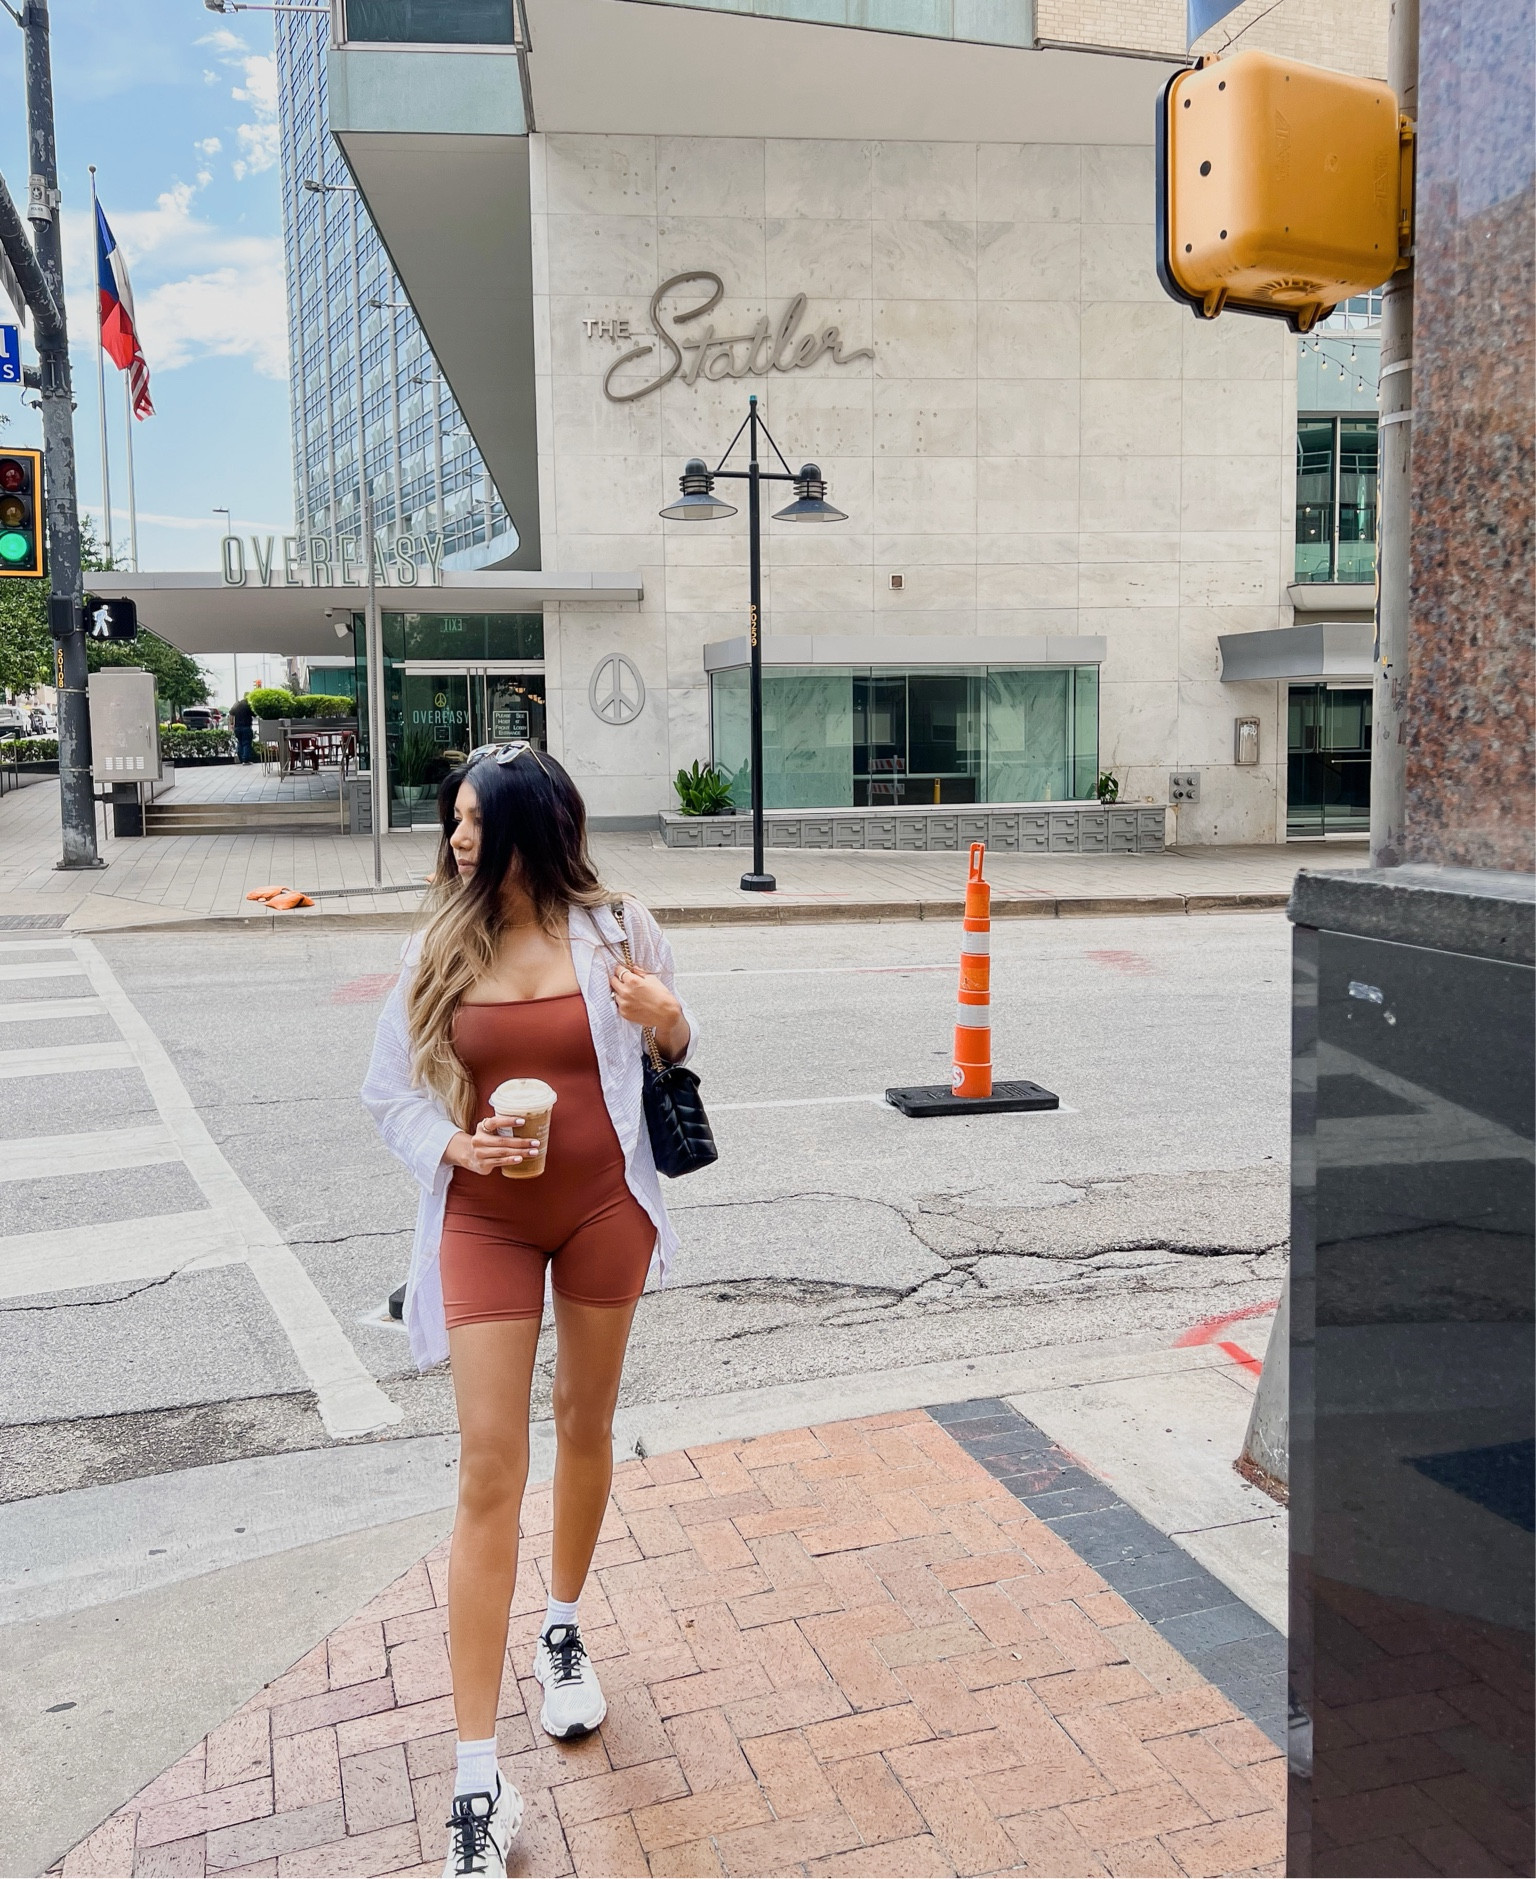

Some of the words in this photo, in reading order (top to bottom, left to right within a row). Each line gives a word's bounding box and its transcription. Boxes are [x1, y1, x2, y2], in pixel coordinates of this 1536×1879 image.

[582, 318, 630, 338] THE
[603, 271, 876, 403] Statler
[3, 364, 15, 379] S
[221, 535, 444, 588] OVEREASY
[412, 710, 470, 724] OVEREASY
